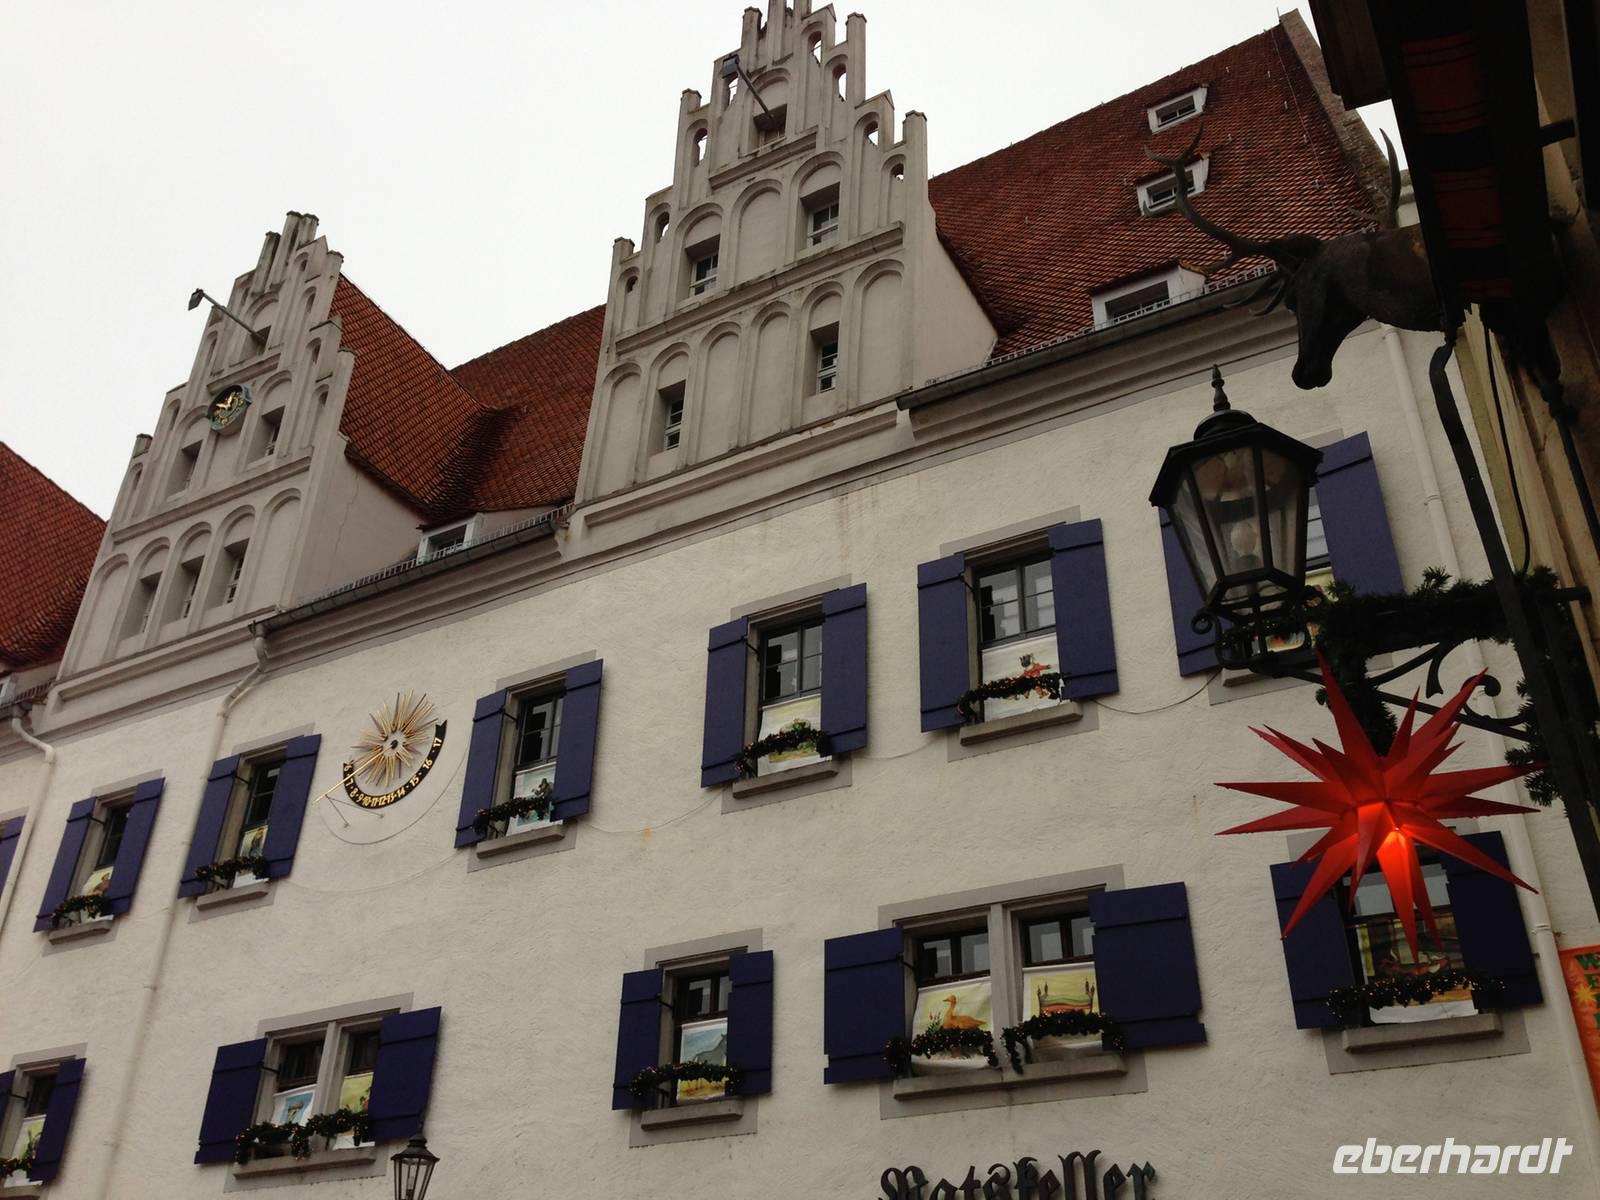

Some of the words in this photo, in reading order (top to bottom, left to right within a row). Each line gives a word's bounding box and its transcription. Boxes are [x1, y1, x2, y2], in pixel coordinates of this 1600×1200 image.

[345, 777, 354, 787] 7
[350, 787, 359, 798] 8
[356, 793, 364, 803] 9
[362, 796, 371, 807] 10
[370, 796, 379, 807] 11
[378, 795, 387, 806] 12
[397, 787, 405, 798] 14
[410, 775, 420, 787] 15
[423, 759, 433, 769] 16
[433, 737, 442, 748] 17
